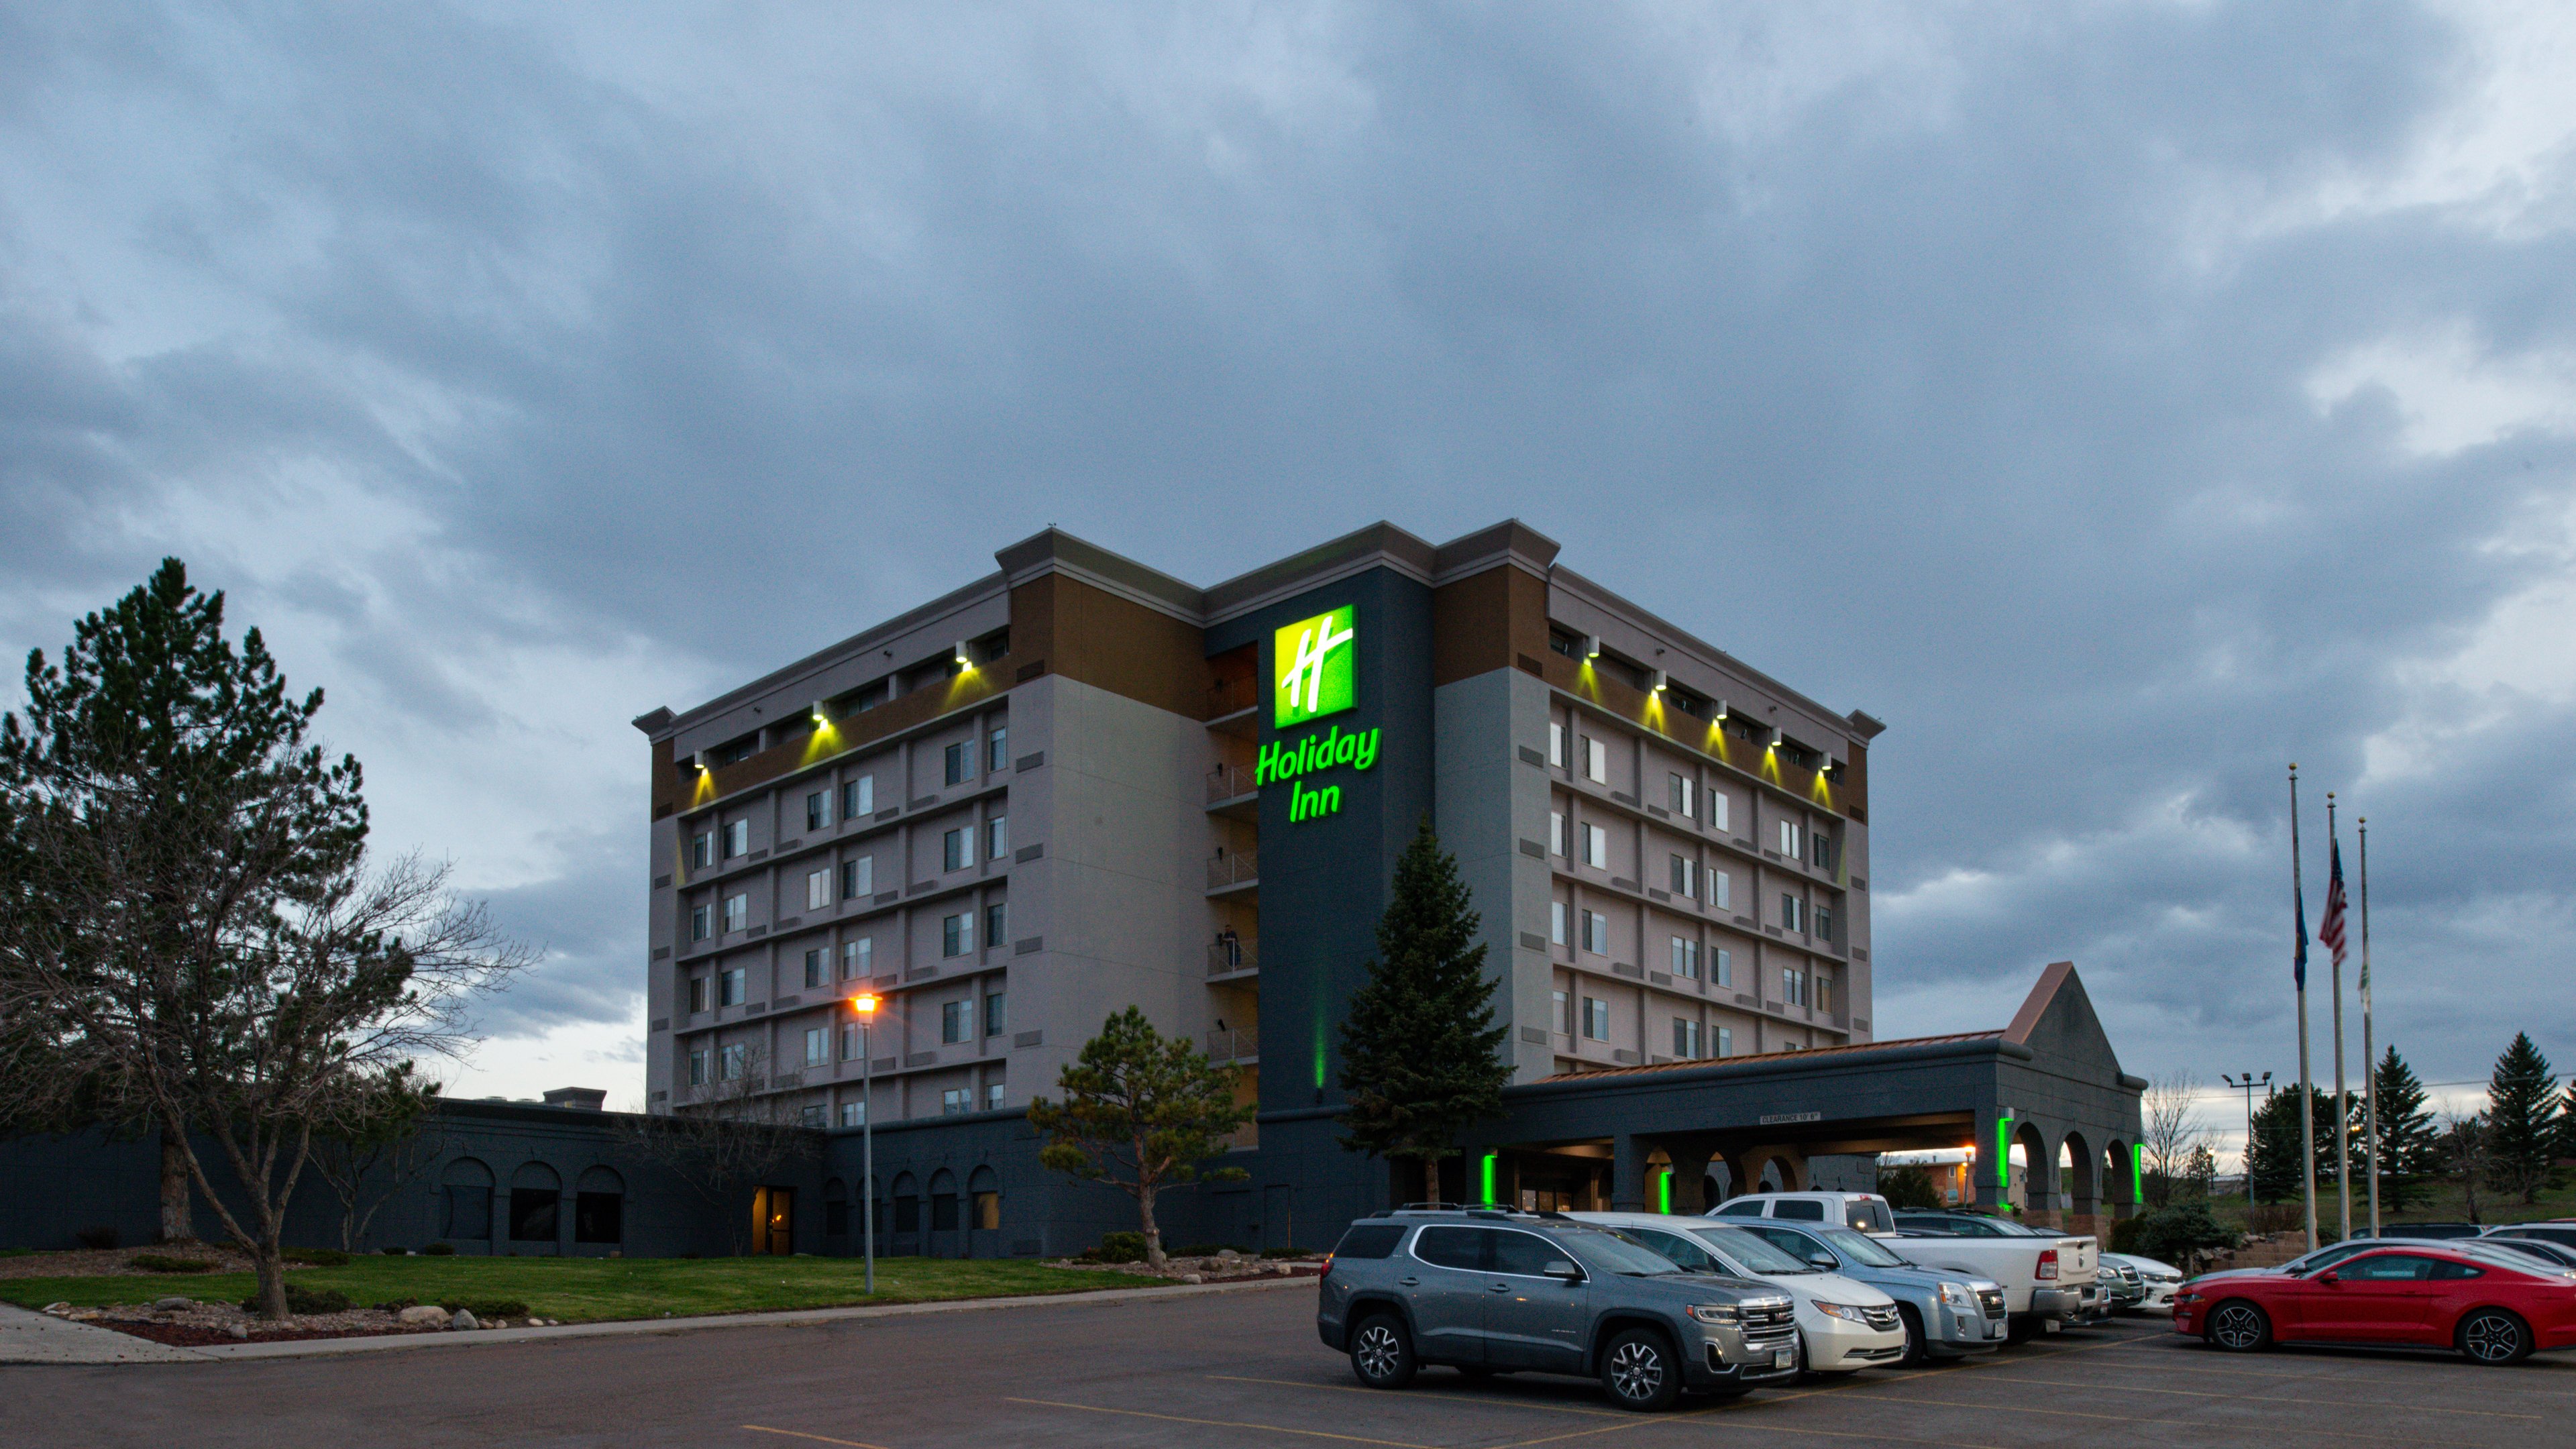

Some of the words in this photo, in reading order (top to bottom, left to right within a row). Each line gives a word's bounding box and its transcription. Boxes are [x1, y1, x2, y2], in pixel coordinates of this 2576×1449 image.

[1255, 725, 1381, 786] Holiday
[1290, 781, 1340, 822] Inn
[1762, 1114, 1798, 1123] CLEARANCE
